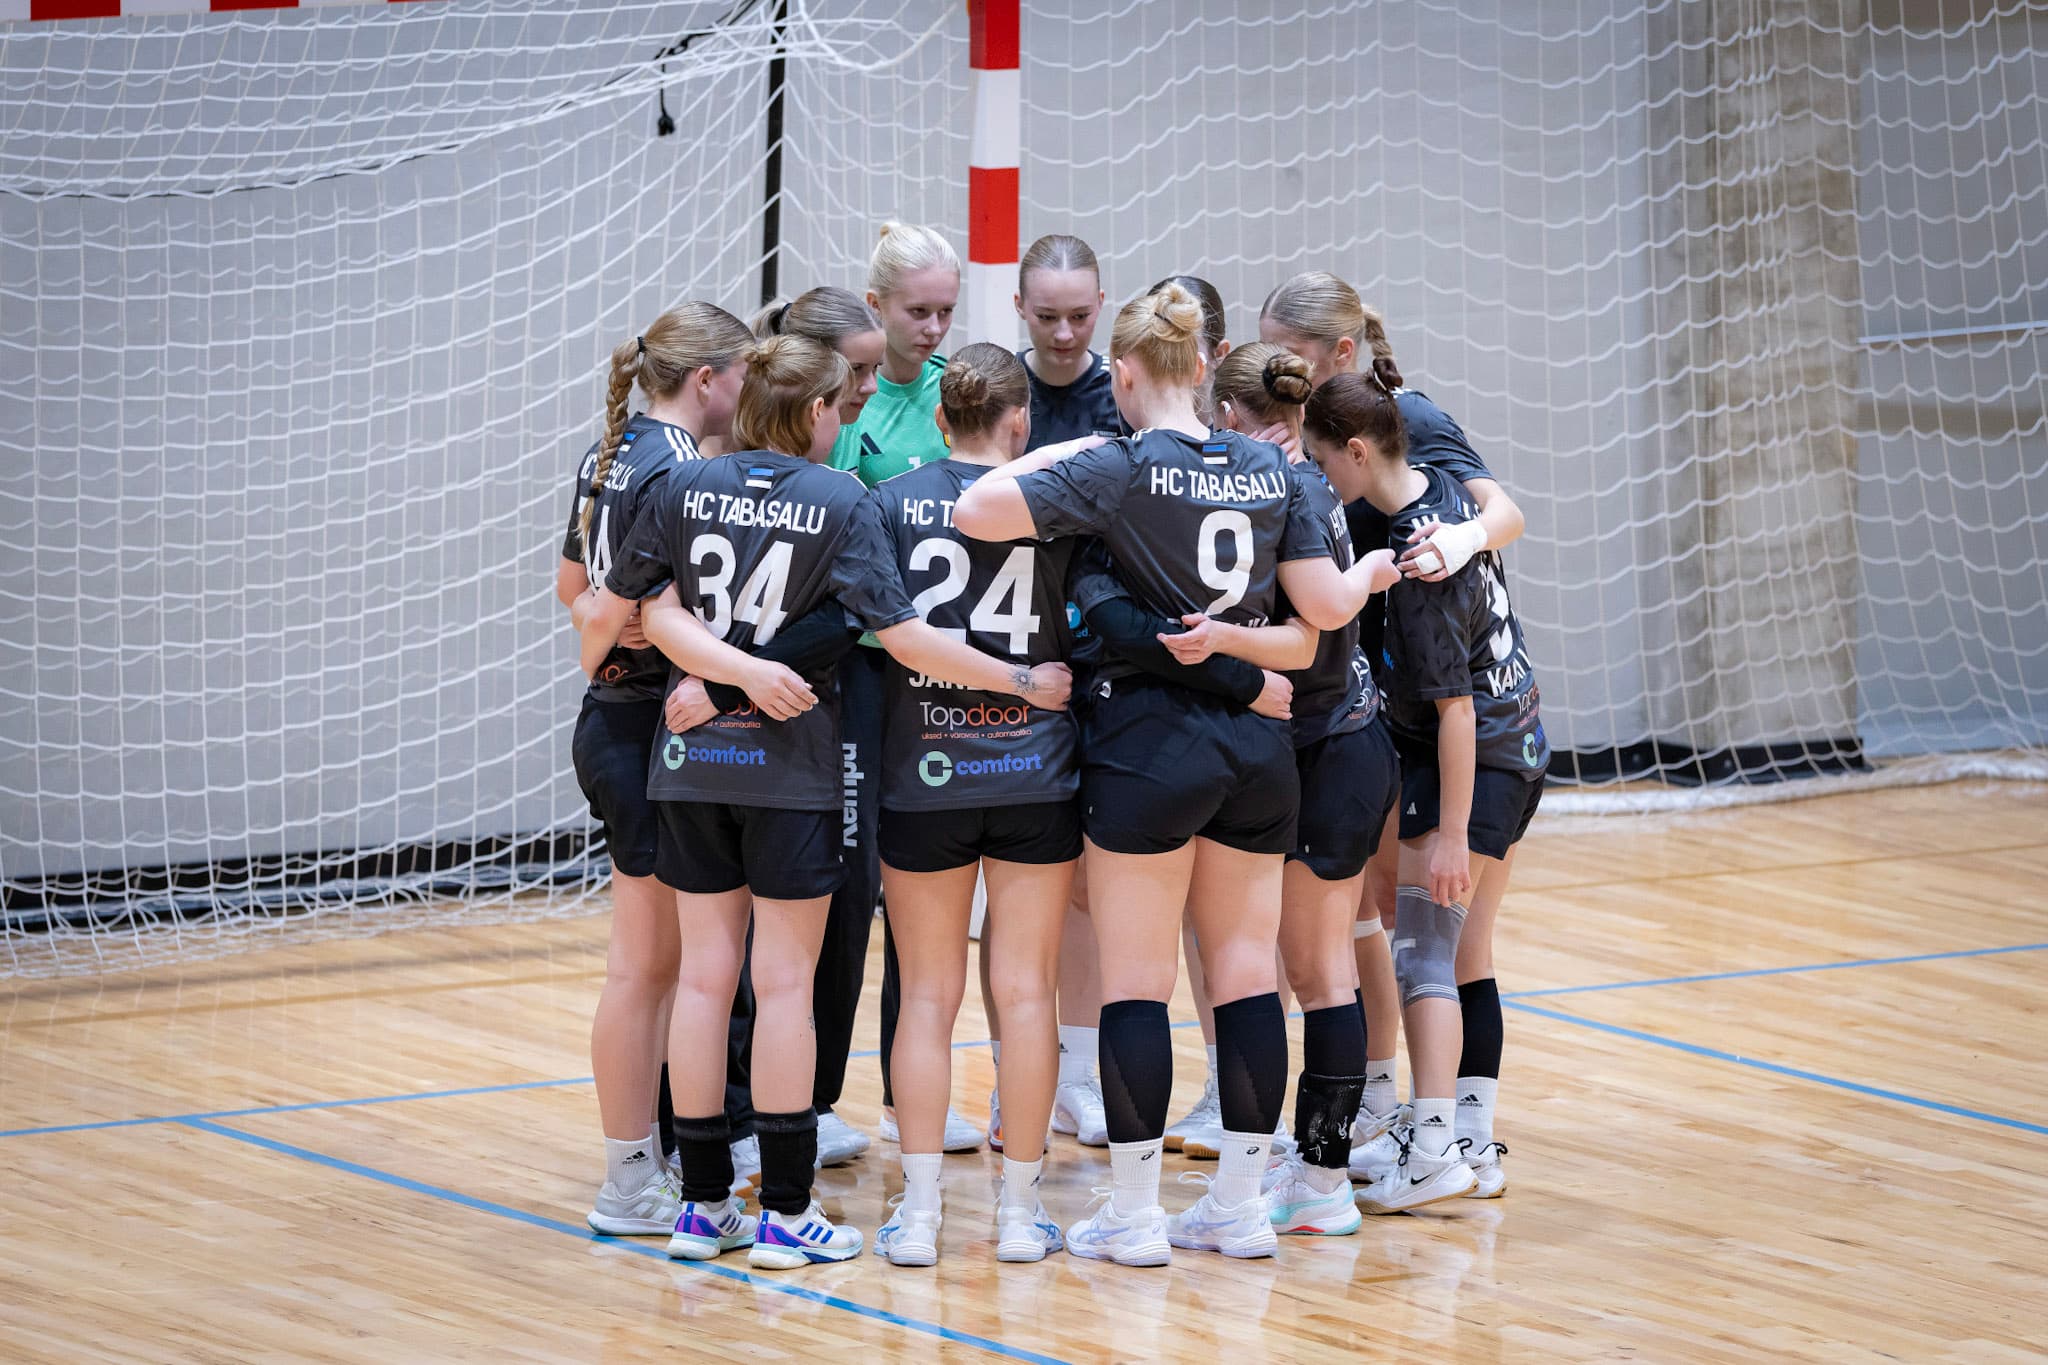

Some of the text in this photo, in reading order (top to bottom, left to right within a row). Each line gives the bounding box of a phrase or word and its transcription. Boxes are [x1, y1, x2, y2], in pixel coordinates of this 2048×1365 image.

[1151, 466, 1287, 502] HC TABASALU
[683, 490, 826, 534] HC TABASALU
[903, 498, 934, 526] HC
[1197, 509, 1255, 615] 9
[690, 533, 795, 646] 34
[909, 537, 1041, 654] 24
[920, 702, 1030, 731] Topdoor
[688, 745, 766, 766] comfort
[955, 753, 1043, 776] comfort
